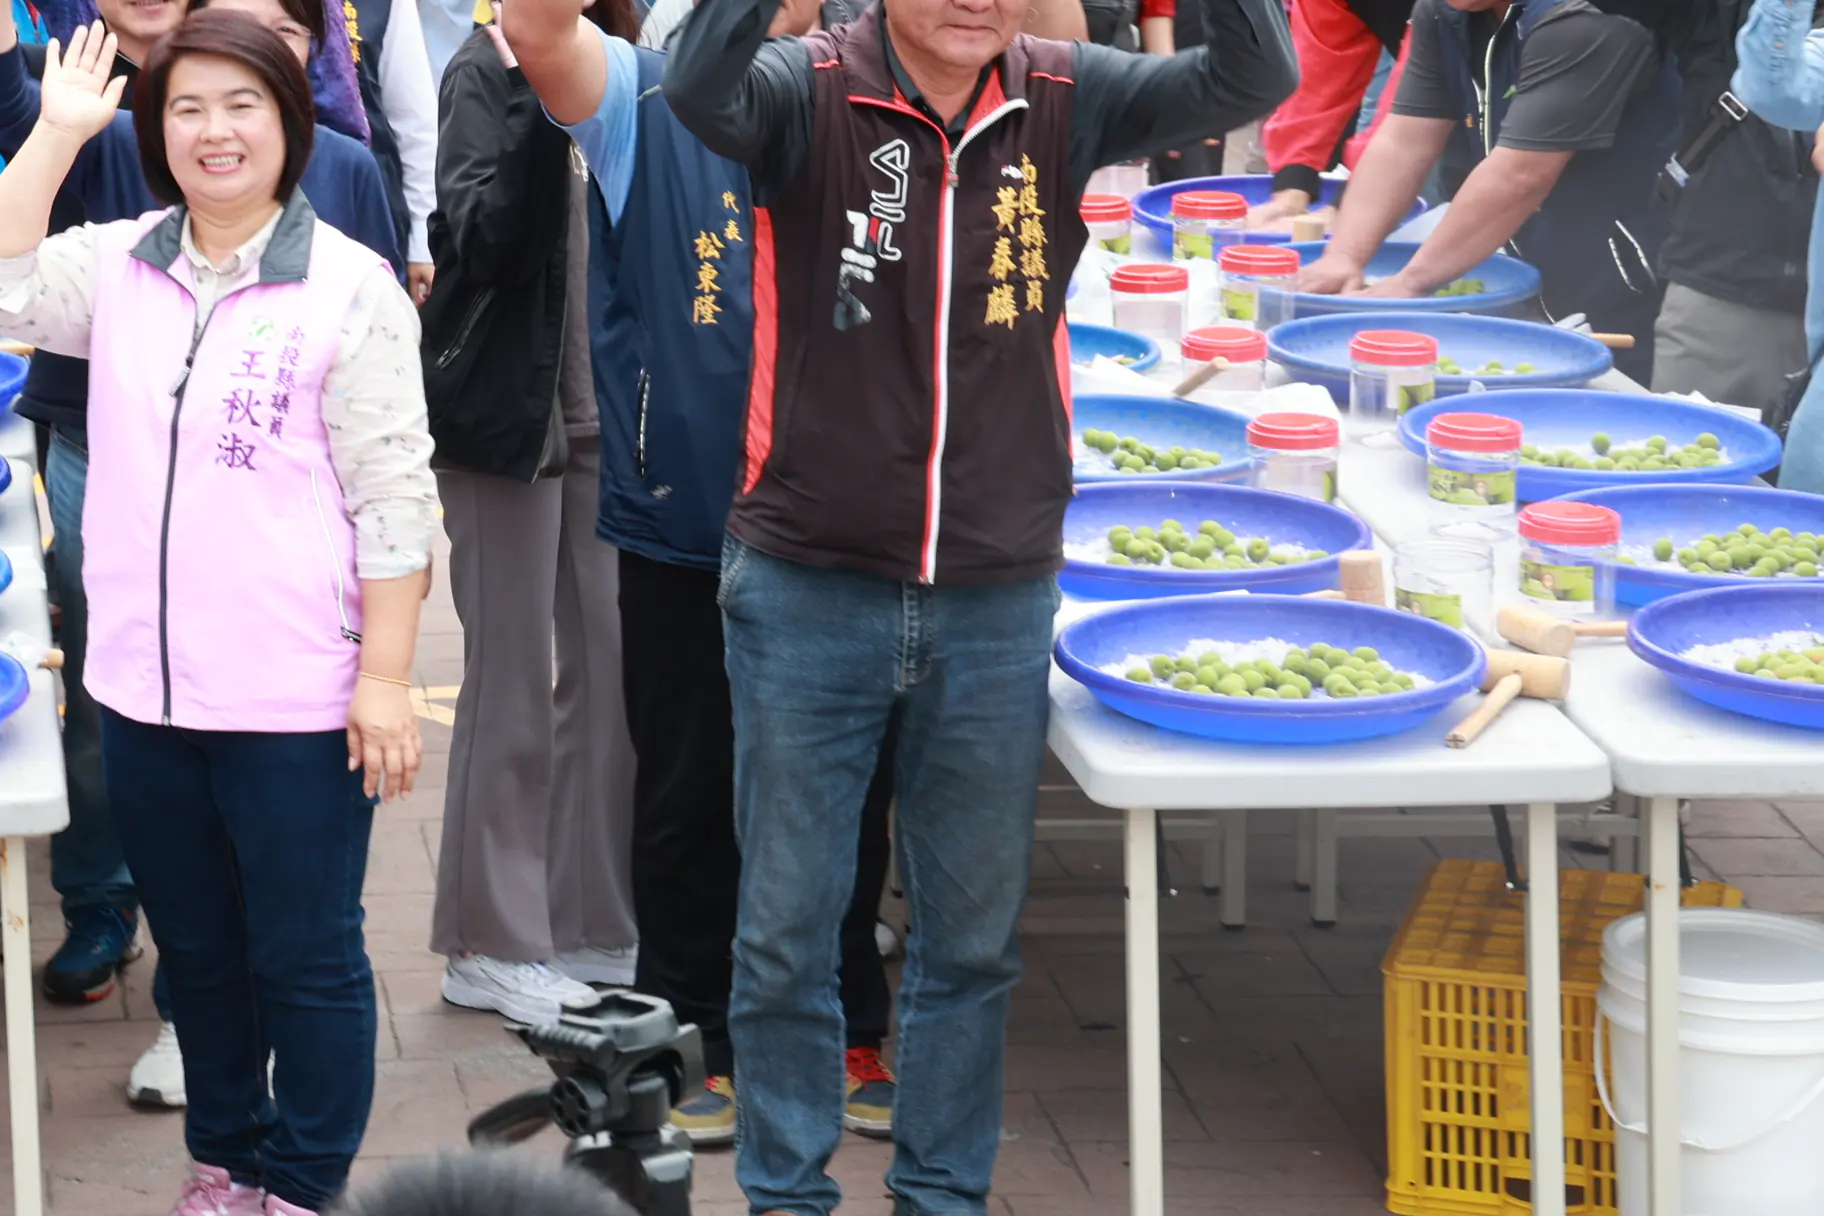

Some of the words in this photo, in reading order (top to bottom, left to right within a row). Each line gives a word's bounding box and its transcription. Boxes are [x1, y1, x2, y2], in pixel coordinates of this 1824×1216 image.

[722, 191, 744, 242] 代表
[869, 138, 910, 261] FILA
[984, 186, 1020, 330] 黃春麟
[1018, 152, 1051, 314] 南投縣議員
[693, 230, 726, 325] 松東隆
[215, 349, 267, 471] 王秋淑
[269, 325, 306, 440] 南投縣議員
